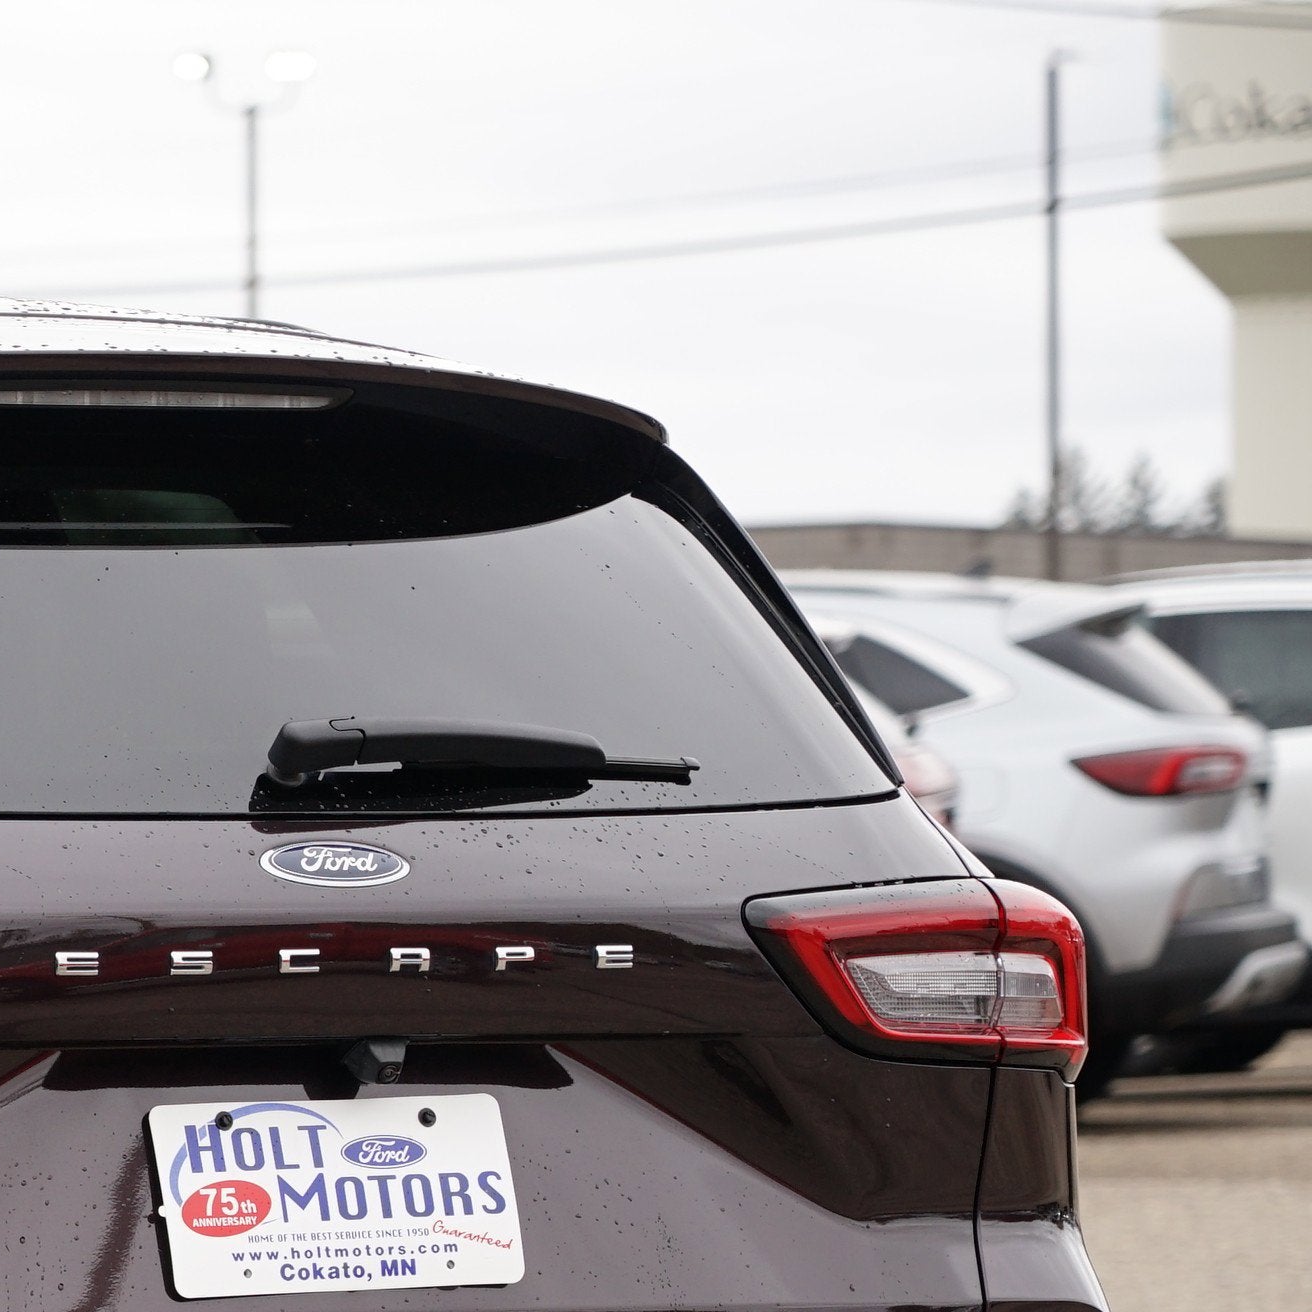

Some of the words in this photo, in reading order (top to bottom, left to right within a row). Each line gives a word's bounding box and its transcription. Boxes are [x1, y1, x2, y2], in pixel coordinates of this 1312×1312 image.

[300, 846, 378, 873] Ford
[55, 944, 634, 977] ESCAPE
[184, 1124, 326, 1173] HOLT
[358, 1139, 410, 1166] Ford
[199, 1187, 257, 1216] 75th
[277, 1171, 506, 1223] MOTORS
[192, 1216, 257, 1227] ANNIVERSARY
[248, 1234, 276, 1243] HOME
[278, 1234, 290, 1242] OF
[291, 1233, 309, 1242] THE
[310, 1232, 333, 1241] BEST
[335, 1230, 373, 1240] SERVICE
[376, 1229, 403, 1239] SINCE
[406, 1227, 430, 1237] 1950
[432, 1219, 514, 1250] Guaranteed
[231, 1241, 459, 1262] www.holtmotors.com
[280, 1261, 373, 1282] Cokato,
[380, 1258, 417, 1277] MN
